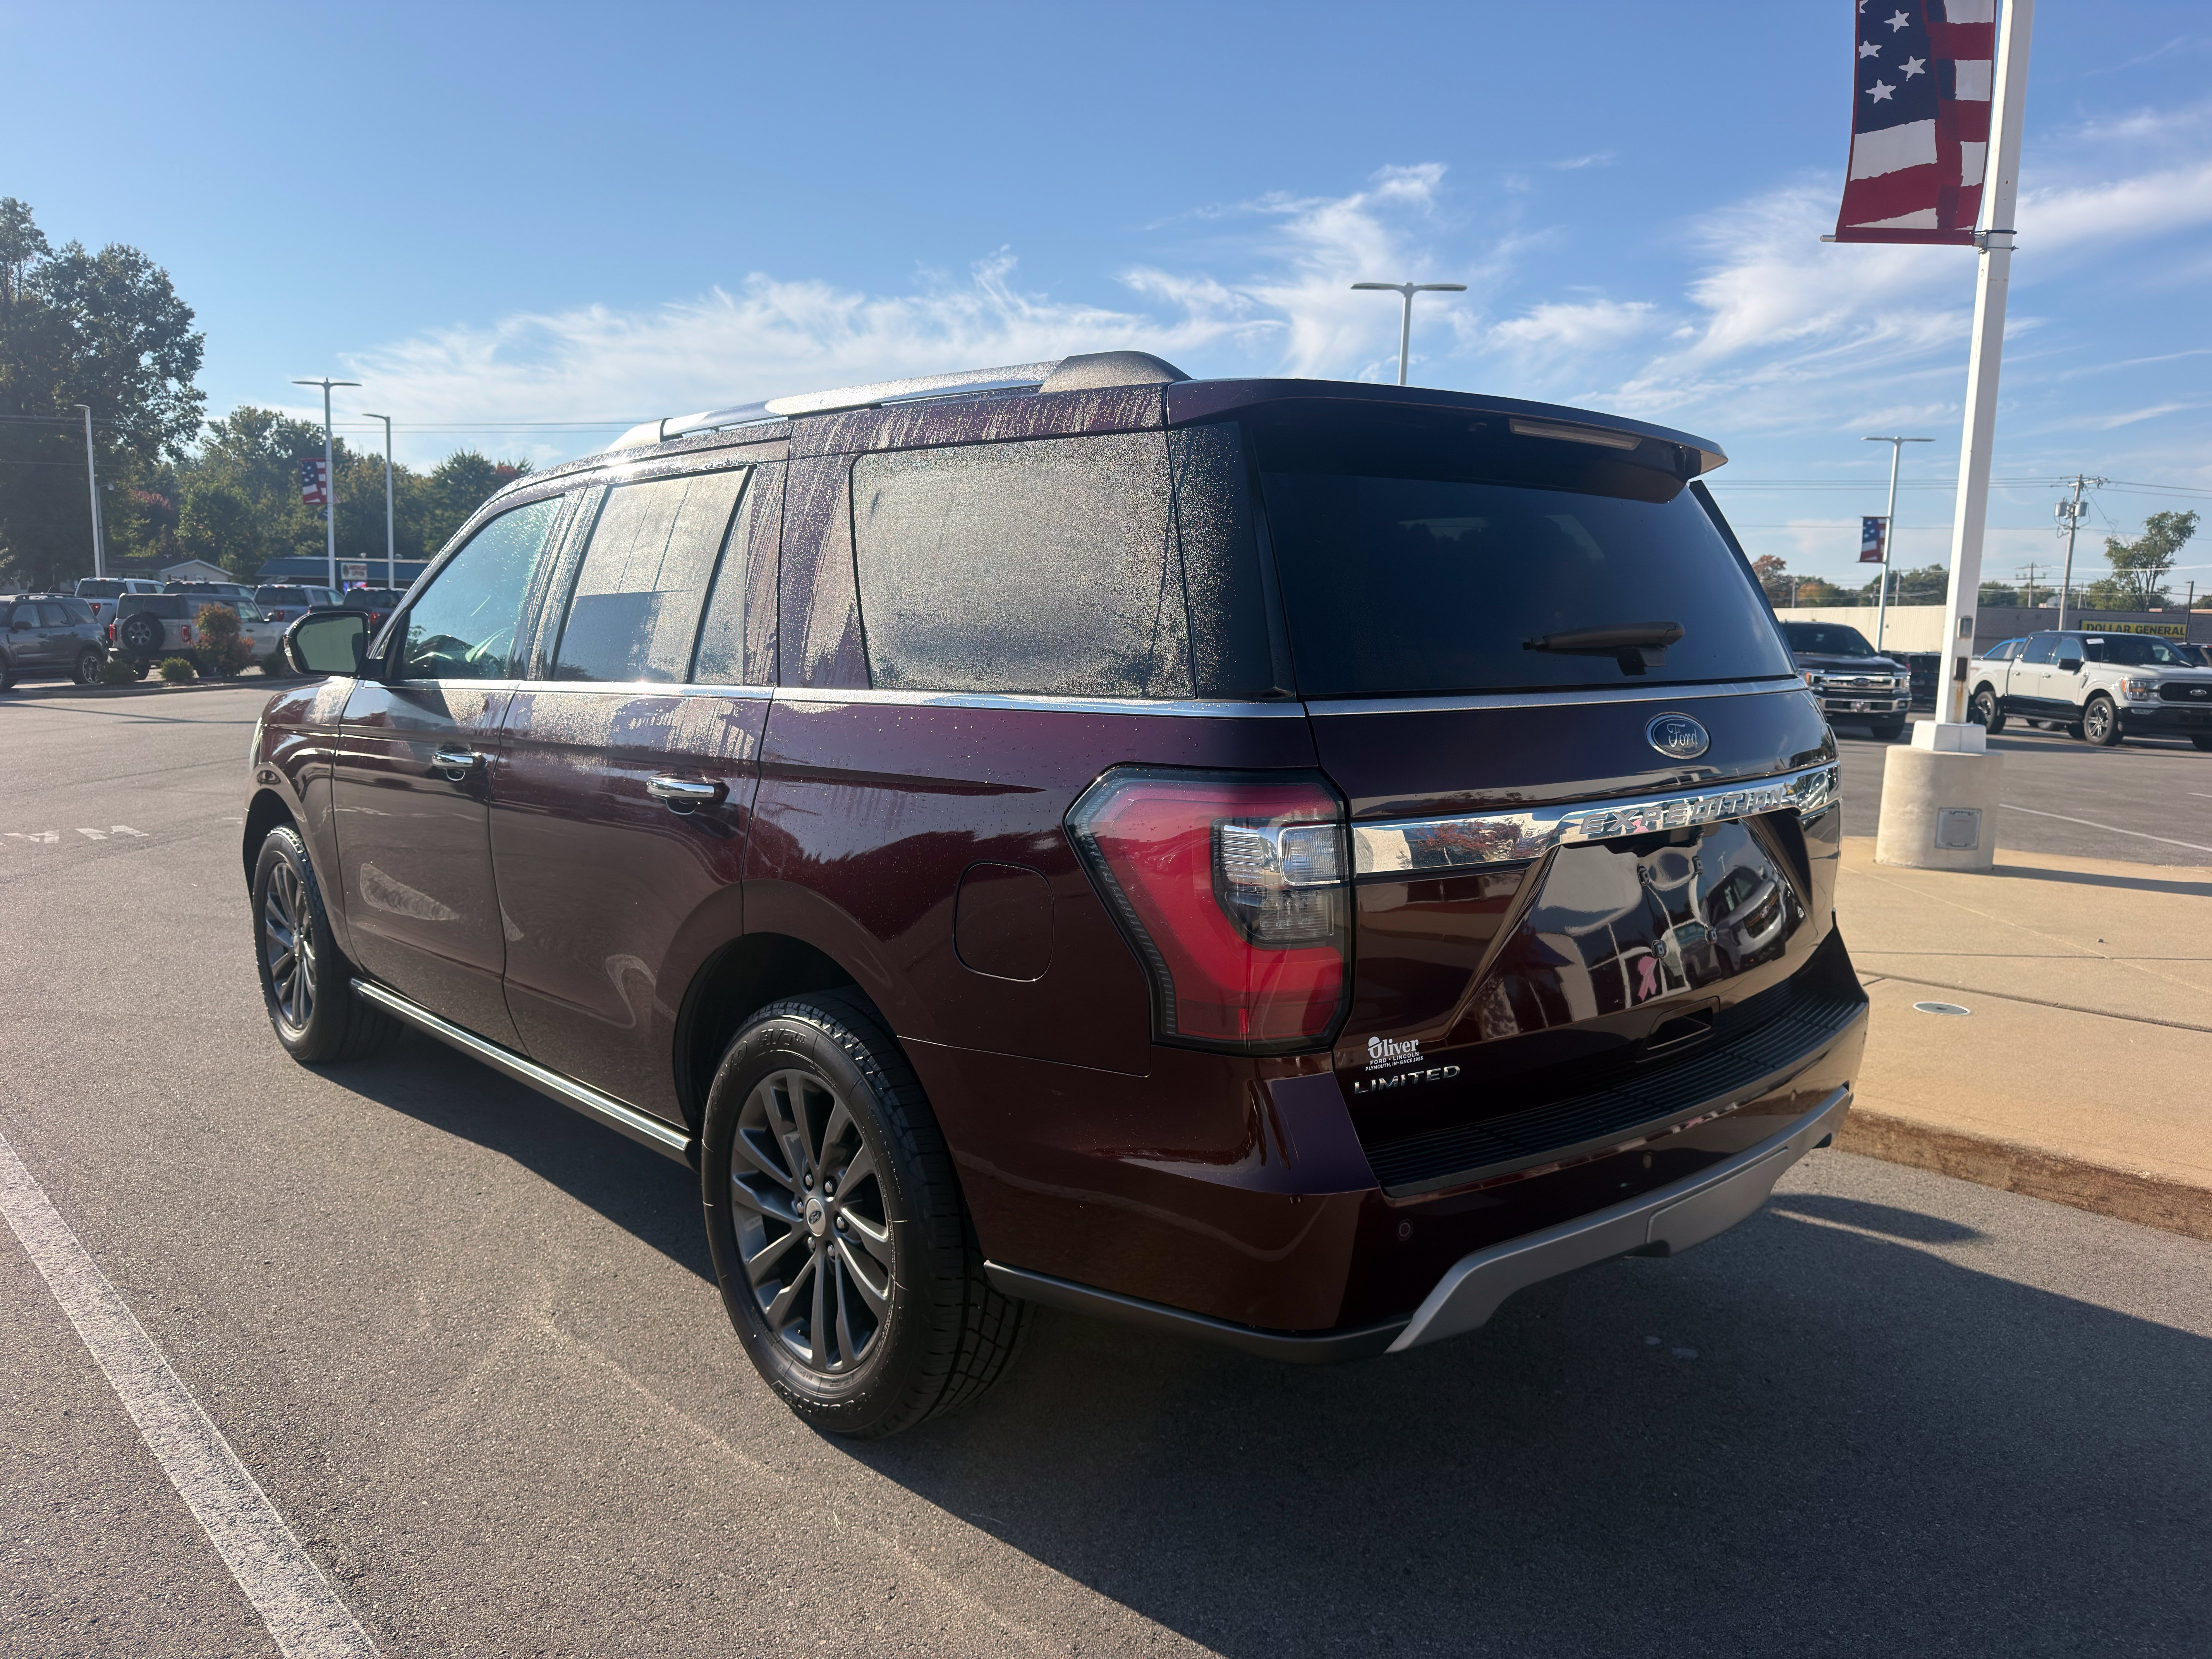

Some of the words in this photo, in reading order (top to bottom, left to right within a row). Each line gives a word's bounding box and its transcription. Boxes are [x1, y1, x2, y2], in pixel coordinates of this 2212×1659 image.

[2087, 623, 2131, 633] DOLLAR
[2135, 625, 2185, 635] GENERAL
[1667, 724, 1698, 747] Ford
[1579, 787, 1784, 834] EXPEDITION
[1367, 1036, 1419, 1058] Oliver
[1393, 1051, 1419, 1061] LINCOLN
[1365, 1063, 1391, 1072] PLYMOUTH,
[1354, 1065, 1460, 1094] LIMITED
